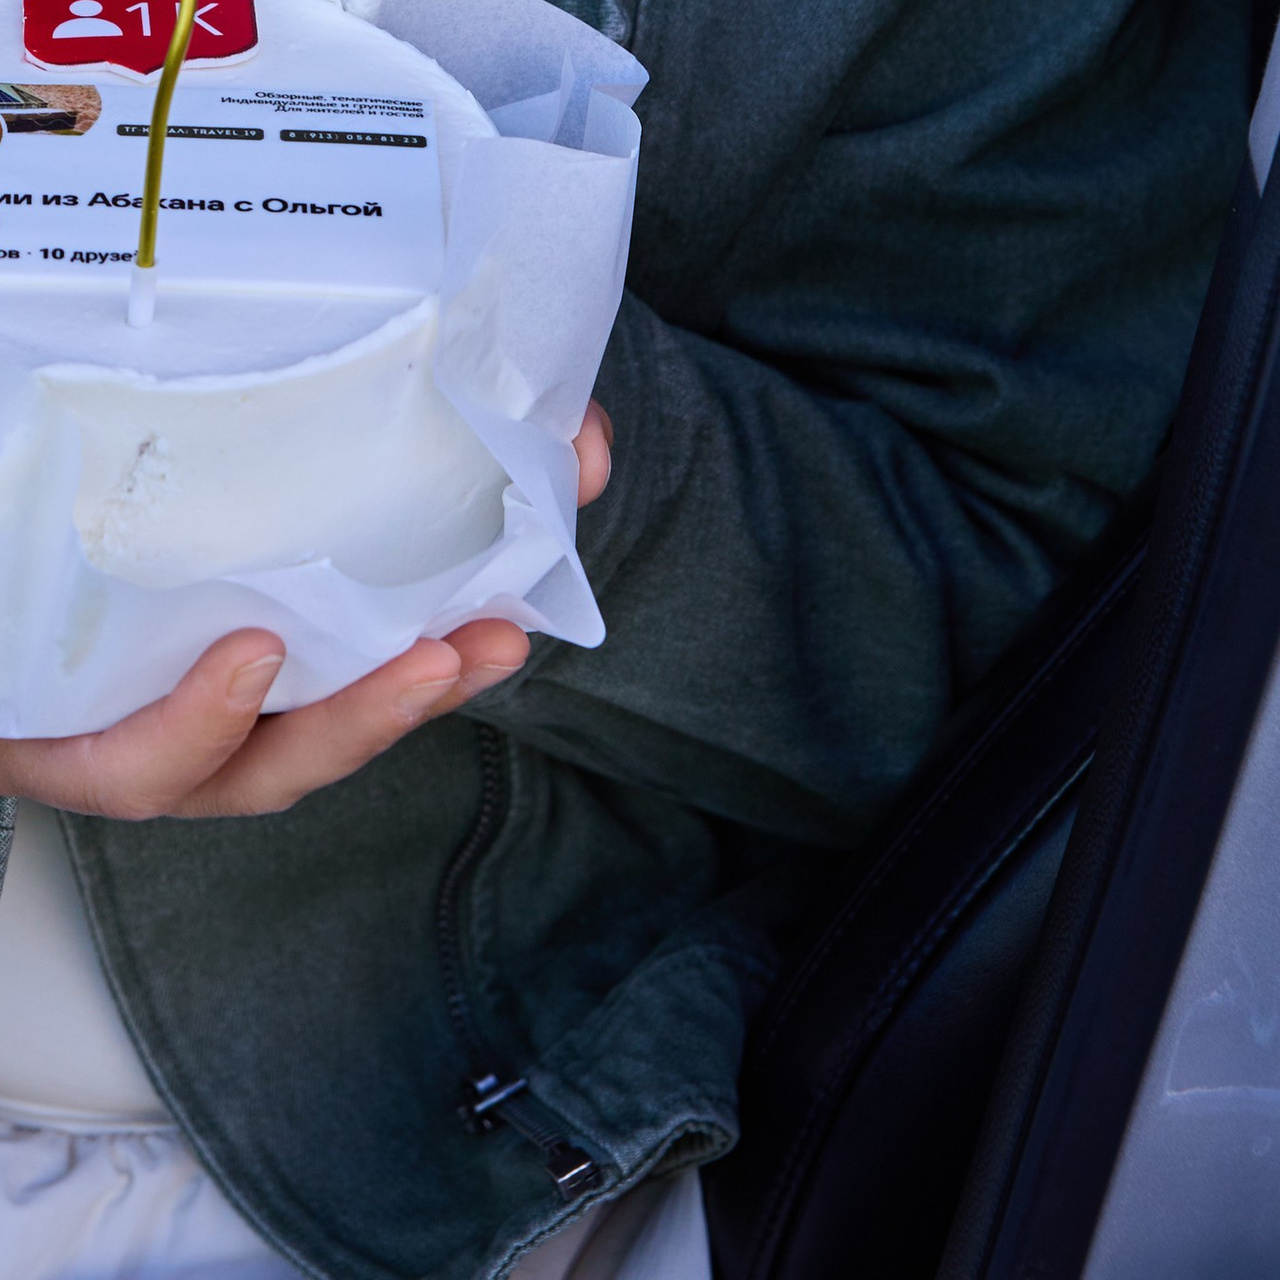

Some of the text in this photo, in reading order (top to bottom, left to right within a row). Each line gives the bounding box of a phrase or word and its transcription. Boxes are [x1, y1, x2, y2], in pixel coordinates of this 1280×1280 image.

[221, 97, 337, 107] Индивидуальные
[353, 102, 424, 113] групповые
[331, 96, 423, 107] тематические
[275, 105, 303, 113] Для
[306, 106, 365, 116] жителей
[380, 108, 424, 119] гостей
[42, 194, 78, 206] из
[234, 200, 253, 212] с
[262, 198, 383, 217] Ольгой
[40, 248, 64, 260] 10
